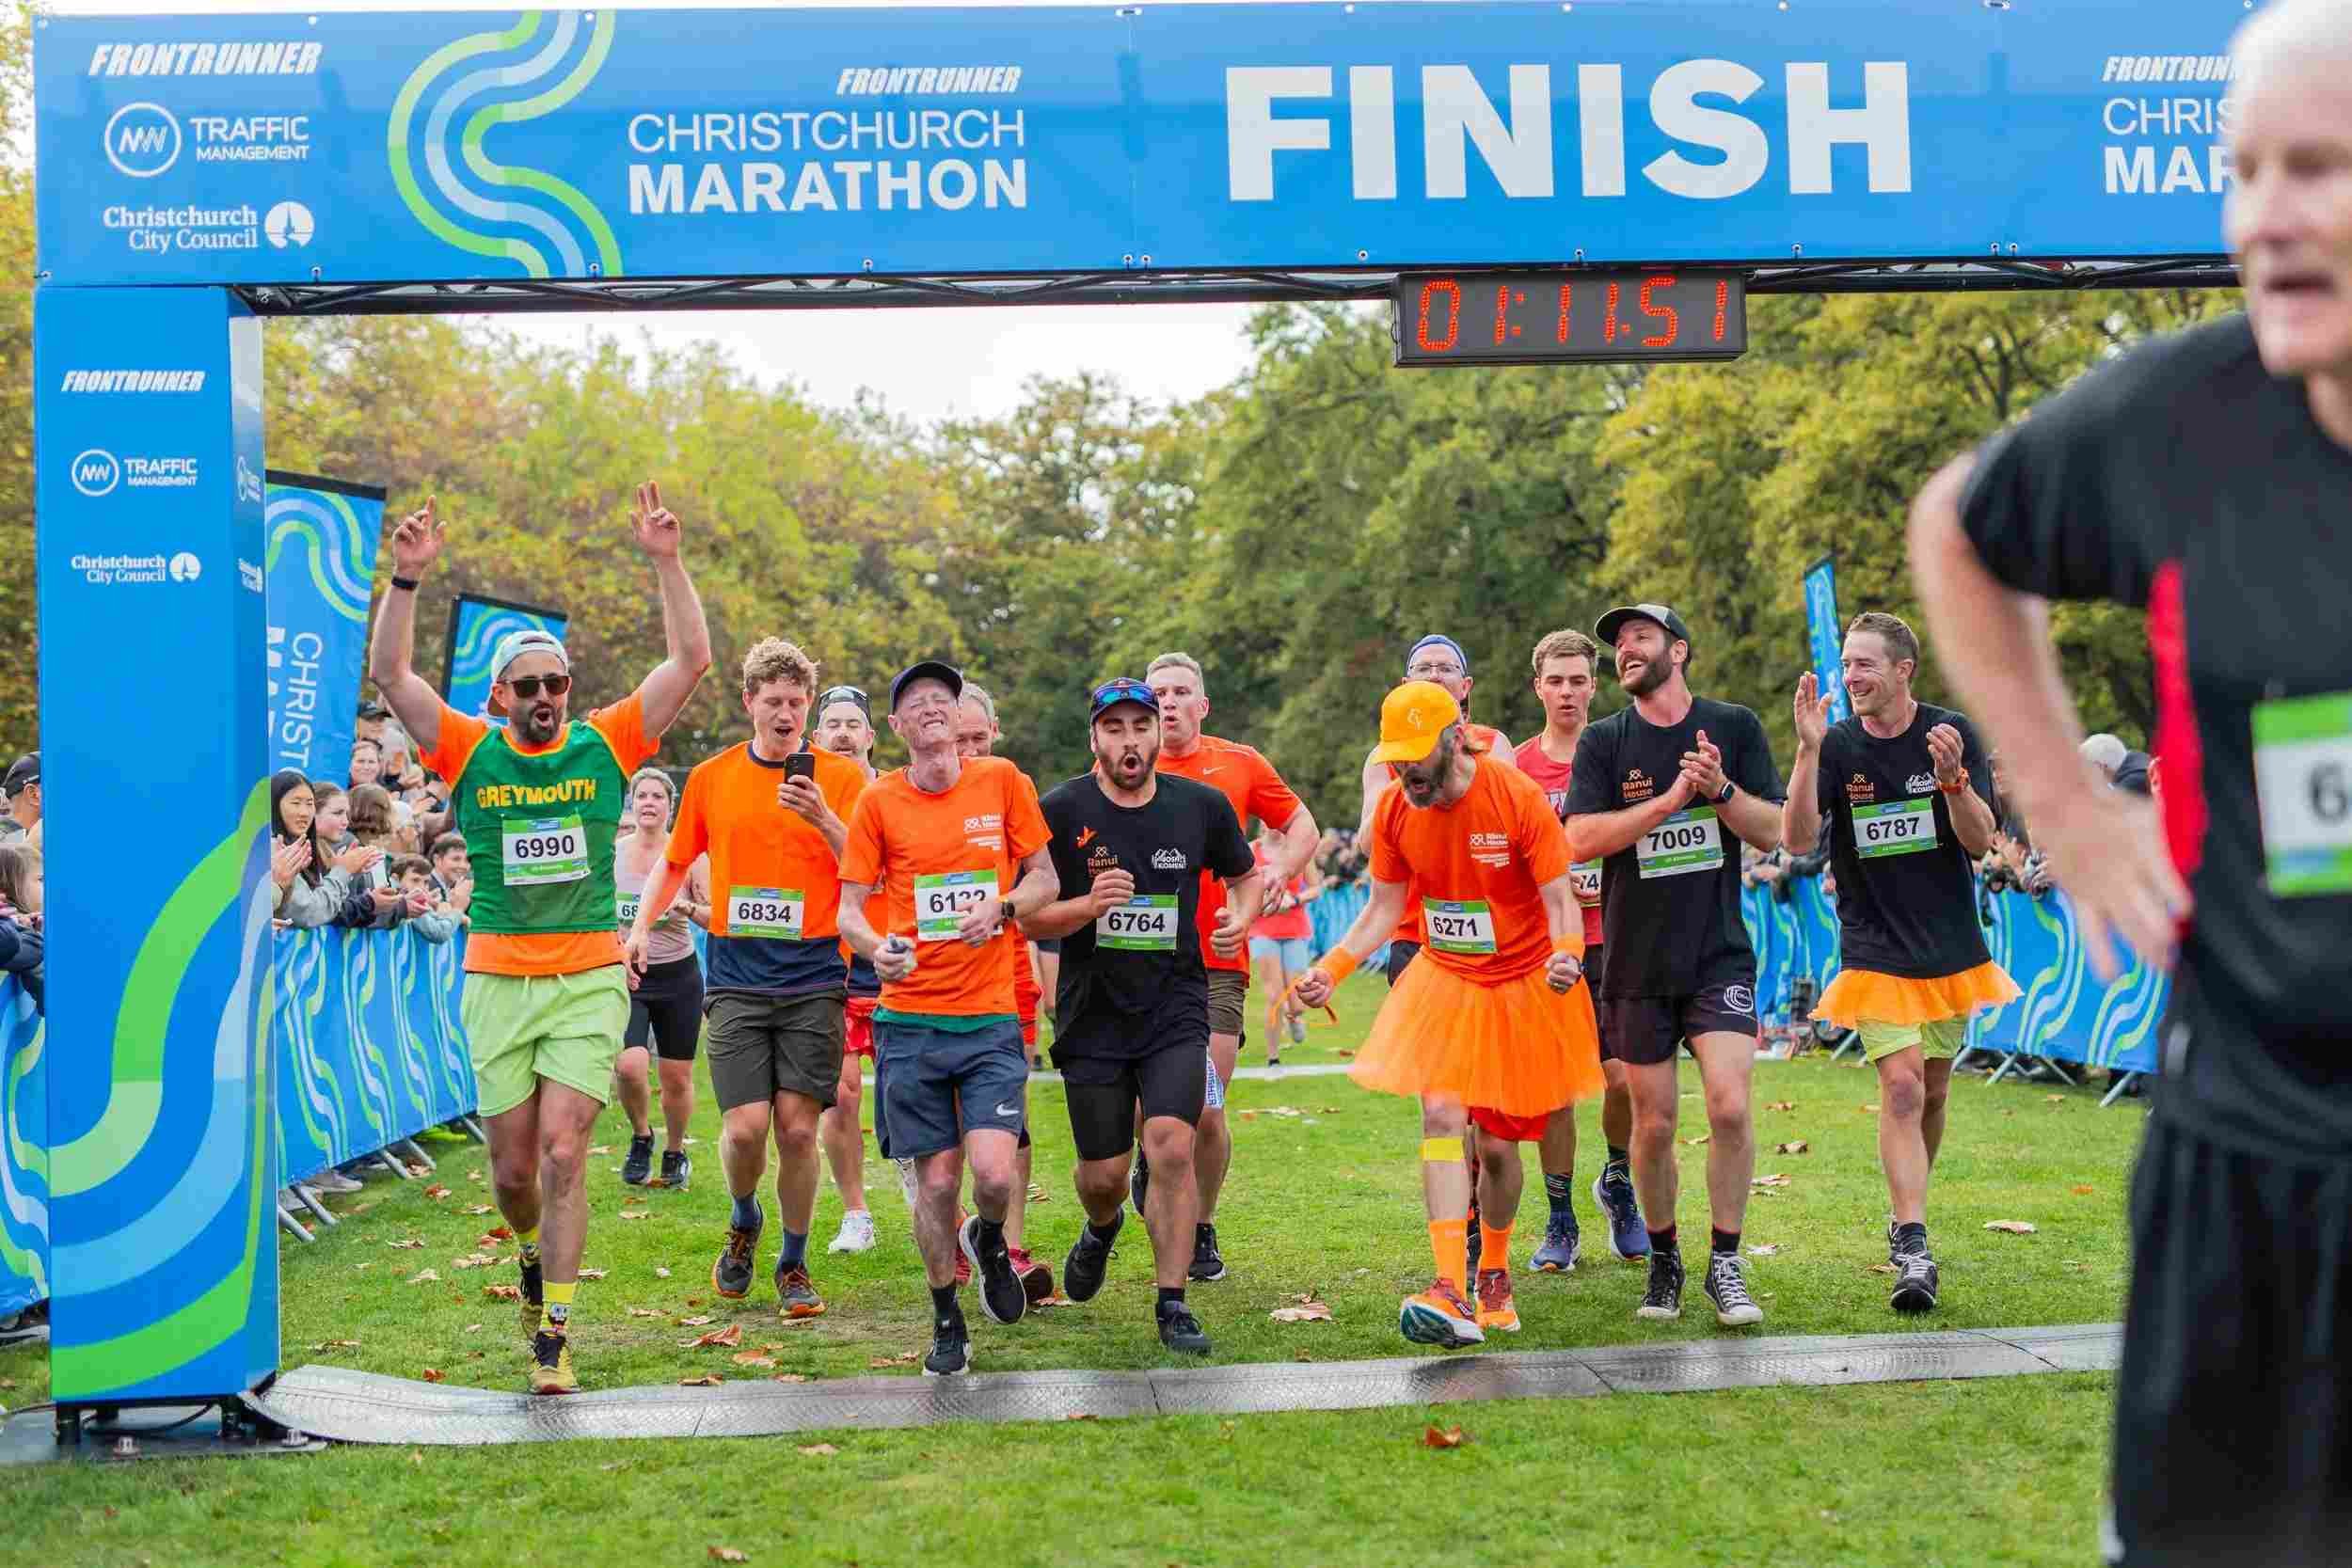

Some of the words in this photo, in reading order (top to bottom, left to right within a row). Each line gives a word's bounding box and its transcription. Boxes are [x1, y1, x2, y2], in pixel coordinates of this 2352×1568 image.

[88, 42, 323, 76] FRONTRUNNER
[836, 67, 1022, 95] FRONTRUNNER
[190, 116, 310, 142] TRAFFIC
[628, 108, 1025, 153] CHRISTCHURCH
[1225, 58, 1912, 201] FINISH
[196, 145, 310, 162] MANAGEMENT
[628, 158, 1027, 214] MARATHON
[103, 205, 258, 229] Christchurch
[129, 229, 172, 254] City
[176, 228, 258, 250] Council
[61, 370, 206, 392] FRONTRUNNER
[124, 458, 197, 474] TRAFFIC
[128, 476, 197, 486] MANAGEMENT
[71, 554, 167, 569] Christchurch
[87, 570, 113, 585] City
[116, 569, 167, 582] Council
[477, 779, 596, 810] GREYMOUTH
[1647, 825, 1707, 851] 7009
[1866, 816, 1920, 841] 6787
[516, 834, 575, 859] 6990
[738, 902, 791, 923] 6834
[1108, 911, 1167, 932] 6764
[1433, 915, 1478, 937] 6271
